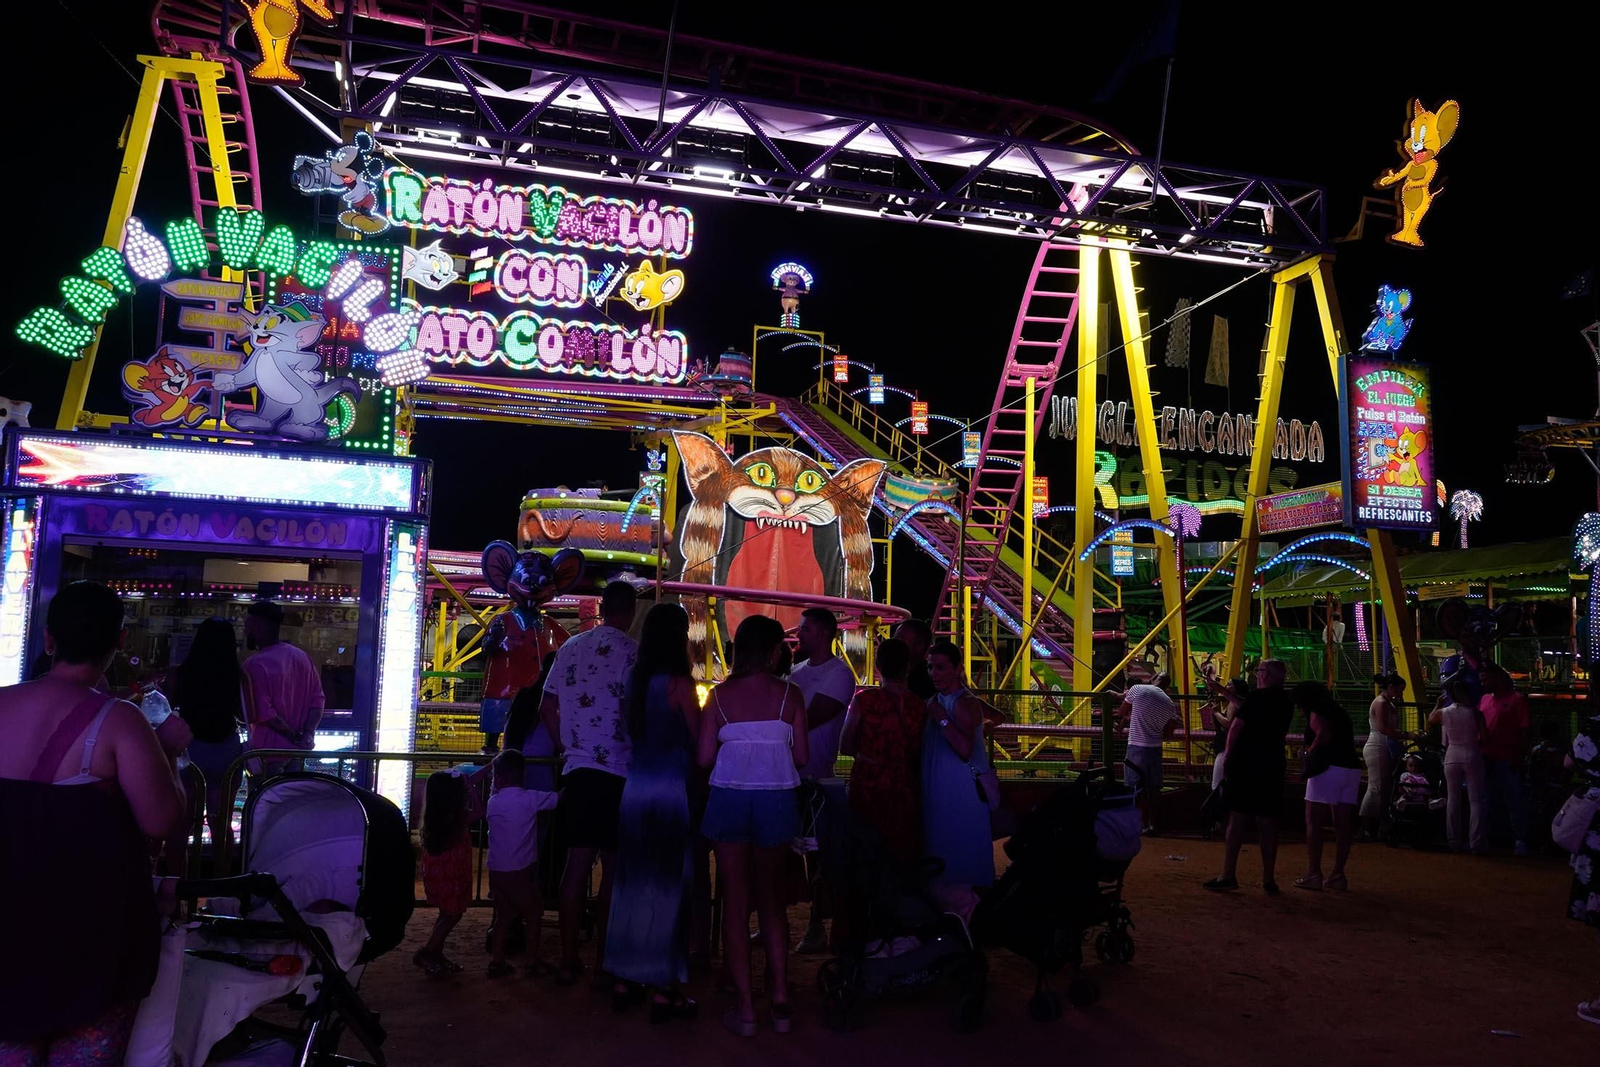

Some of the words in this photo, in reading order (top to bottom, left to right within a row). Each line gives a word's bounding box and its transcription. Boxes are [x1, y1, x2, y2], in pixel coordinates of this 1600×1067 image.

[392, 174, 523, 232] RATÓN
[530, 190, 687, 252] VACILÓN
[502, 256, 580, 301] CON
[505, 317, 681, 376] COMILÓN
[190, 351, 237, 367] TICKETS
[1355, 370, 1426, 398] EMPIEZA
[1367, 391, 1381, 404] EL
[1356, 406, 1385, 421] Pulse
[1386, 410, 1397, 423] el
[1049, 395, 1140, 446] JUGL
[1161, 406, 1325, 463] ENCANADA
[1367, 485, 1380, 495] SI
[1383, 486, 1423, 498] DESEA
[1367, 496, 1423, 509] EFECTOS
[85, 503, 200, 539] RATÓN
[209, 508, 348, 547] VACILÓN
[1359, 506, 1432, 523] REFRESCANTES
